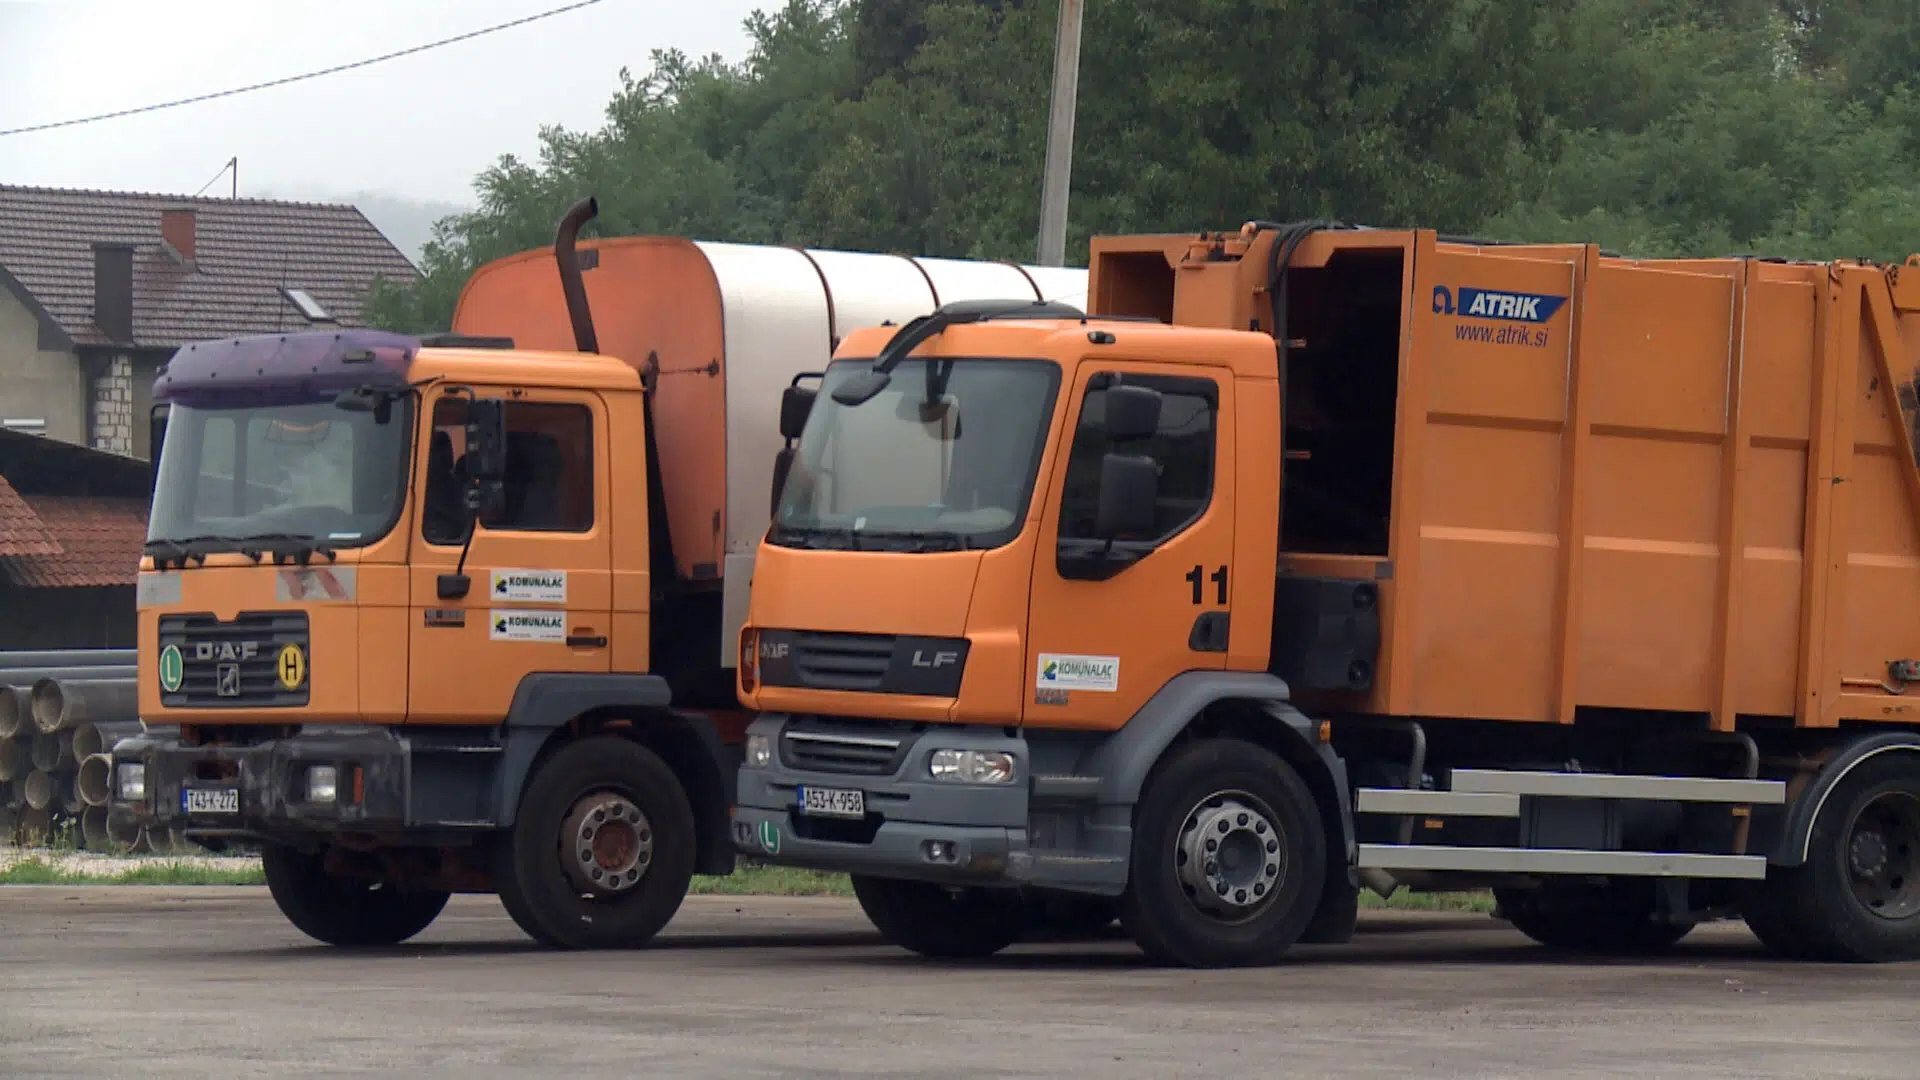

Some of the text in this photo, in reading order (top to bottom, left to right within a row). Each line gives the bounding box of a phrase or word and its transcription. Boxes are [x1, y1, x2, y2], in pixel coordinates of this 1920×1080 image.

[1469, 292, 1541, 320] ATRIK
[1455, 324, 1549, 348] www.atrik.si
[1186, 564, 1228, 605] 11
[166, 655, 177, 683] L
[285, 653, 297, 681] H
[912, 649, 958, 668] LF
[806, 789, 861, 813] A53-K-958
[764, 820, 775, 849] L
